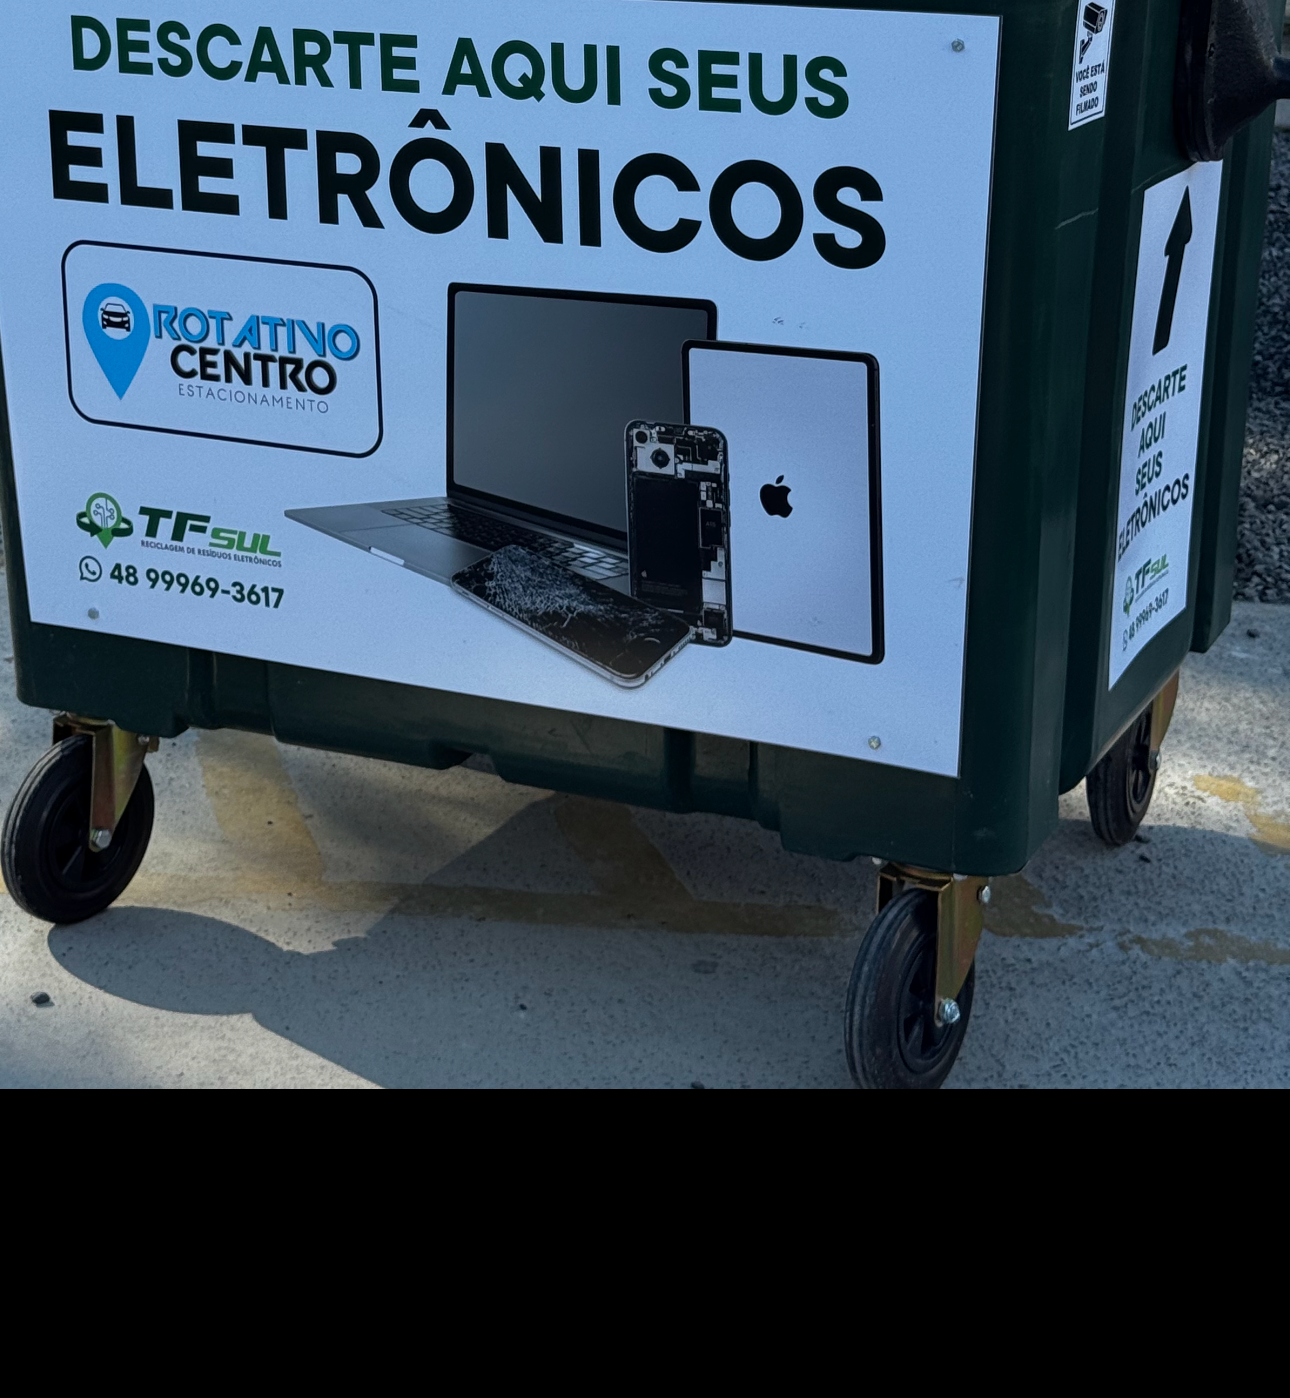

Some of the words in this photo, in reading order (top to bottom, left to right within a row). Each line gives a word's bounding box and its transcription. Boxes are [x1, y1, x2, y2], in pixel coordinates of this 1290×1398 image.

[70, 14, 420, 93] DESCARTE
[442, 37, 621, 106] AQUI
[648, 47, 849, 119] SEUS
[1075, 65, 1089, 83] VOCÊ
[1090, 59, 1105, 78] ESTÁ
[1079, 80, 1098, 98] SENDO
[1075, 96, 1099, 116] FILMADO
[48, 108, 887, 270] ELETRÔNICOS
[153, 303, 360, 361] ROTATIVO
[170, 343, 337, 395] CENTRO
[178, 383, 329, 414] ESTACIONAMENTO
[1131, 364, 1187, 432] DESCARTE
[1137, 411, 1166, 458] AQUI
[1135, 451, 1163, 496] SEUS
[1117, 473, 1190, 562] ELETRÔNICOS
[140, 539, 185, 553] RECICLAGEM
[186, 547, 196, 555] DE
[197, 548, 232, 561] RESÍDUOS
[233, 553, 282, 568] ELETRÔNICOS
[110, 563, 139, 586] 48
[146, 568, 285, 609] 99969-3617
